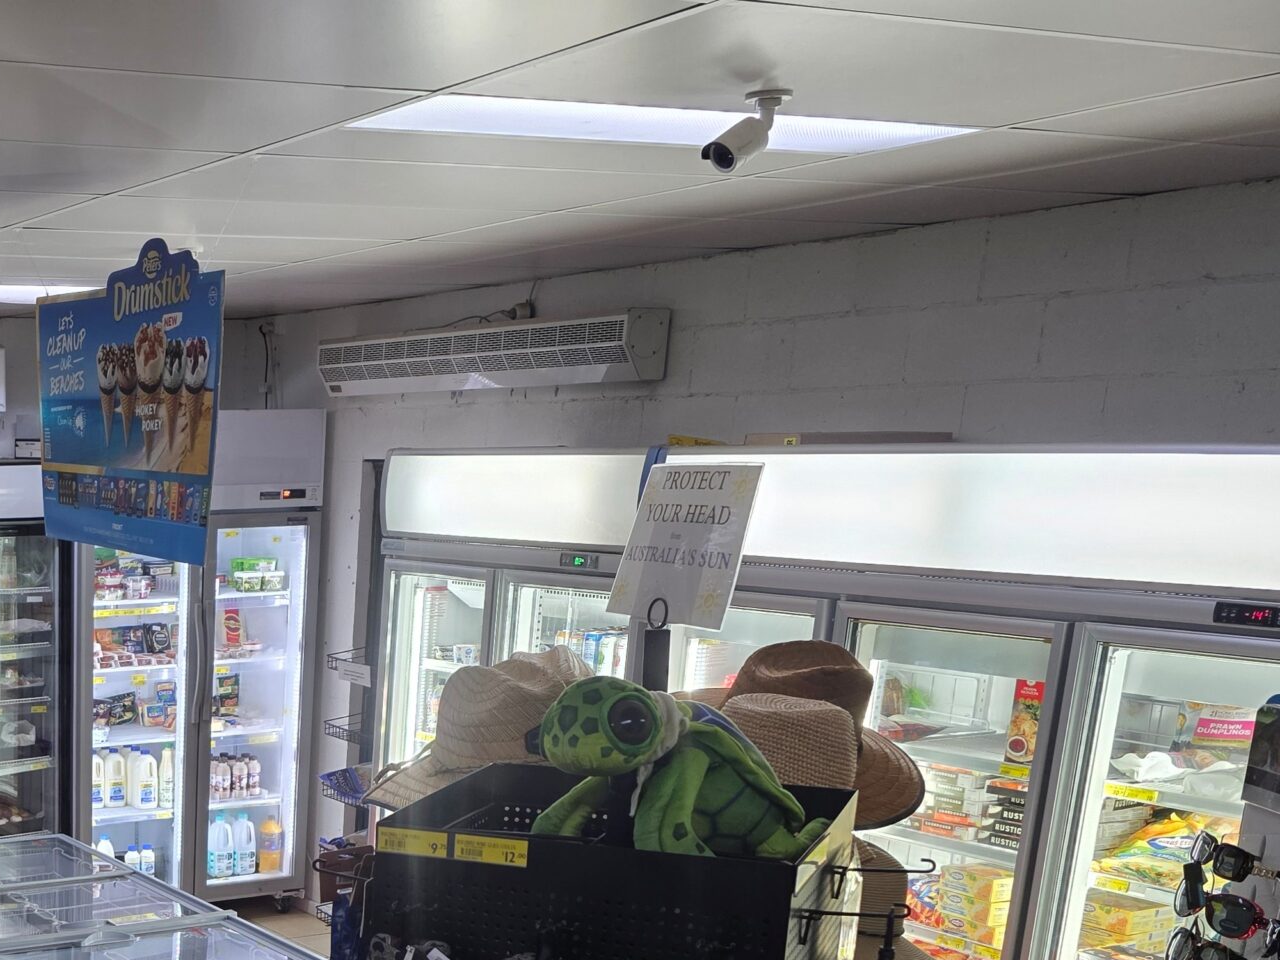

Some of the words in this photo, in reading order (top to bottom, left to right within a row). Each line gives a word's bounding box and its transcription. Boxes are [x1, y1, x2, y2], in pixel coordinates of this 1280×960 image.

[113, 264, 190, 321] Drumstick
[163, 314, 178, 327] NEW
[49, 371, 84, 396] BEACHES
[135, 404, 158, 416] HOKEY
[142, 419, 162, 432] POKEY
[662, 470, 731, 491] PROTECT
[646, 503, 683, 523] YOUR
[684, 504, 731, 525] HEAD
[625, 546, 698, 567] AUSTRALIA'S
[698, 552, 732, 570] SUN
[1197, 726, 1252, 736] DUMPLINGS
[1210, 722, 1243, 730] PRAWN
[1003, 811, 1024, 821] RUST
[995, 823, 1022, 835] RUSTIC
